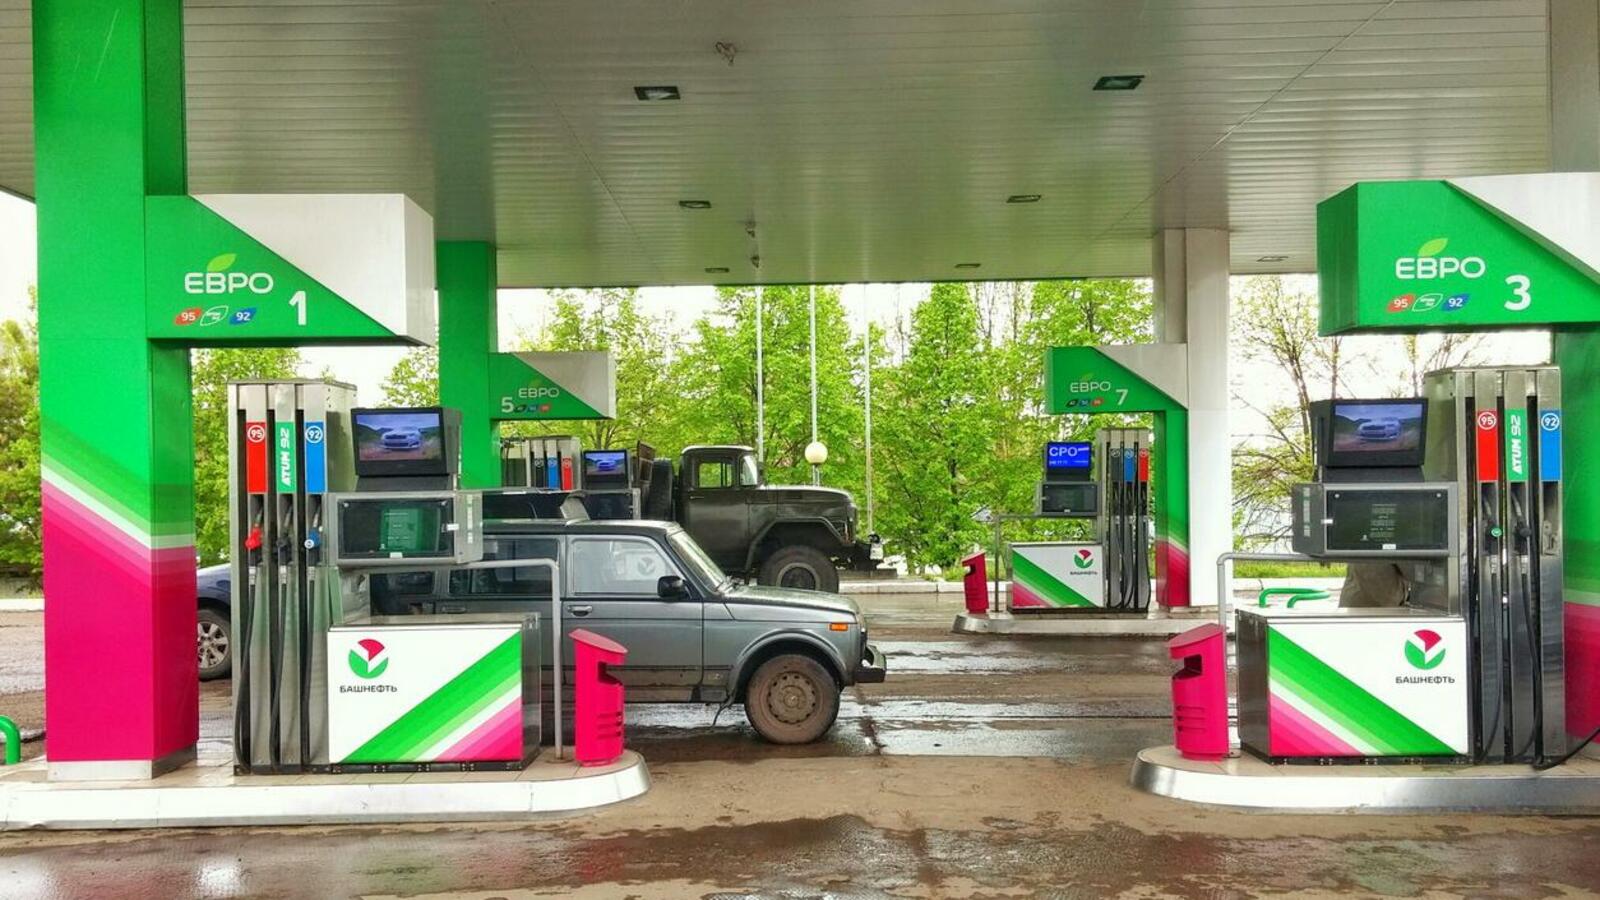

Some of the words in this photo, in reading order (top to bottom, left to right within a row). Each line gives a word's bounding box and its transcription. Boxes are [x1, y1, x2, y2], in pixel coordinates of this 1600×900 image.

[1395, 256, 1486, 279] ЕВРО
[184, 272, 274, 294] ЕВРО
[1503, 274, 1531, 311] 3
[288, 290, 306, 326] 1
[1393, 299, 1408, 308] 95
[1448, 298, 1463, 307] 92
[181, 312, 196, 321] 95
[236, 312, 251, 321] 92
[518, 387, 560, 398] ЕВРО
[1070, 381, 1111, 393] ЕВРО
[1115, 388, 1129, 406] 7
[501, 396, 514, 413] 5
[1480, 416, 1494, 425] 95
[1511, 414, 1521, 437] 92
[1544, 417, 1557, 427] 92
[250, 429, 263, 439] 95
[280, 427, 291, 449] 92
[308, 429, 321, 440] 92
[1395, 675, 1456, 684] БАШНЕФТЬ
[339, 684, 398, 694] БАШНЕФТЬ
